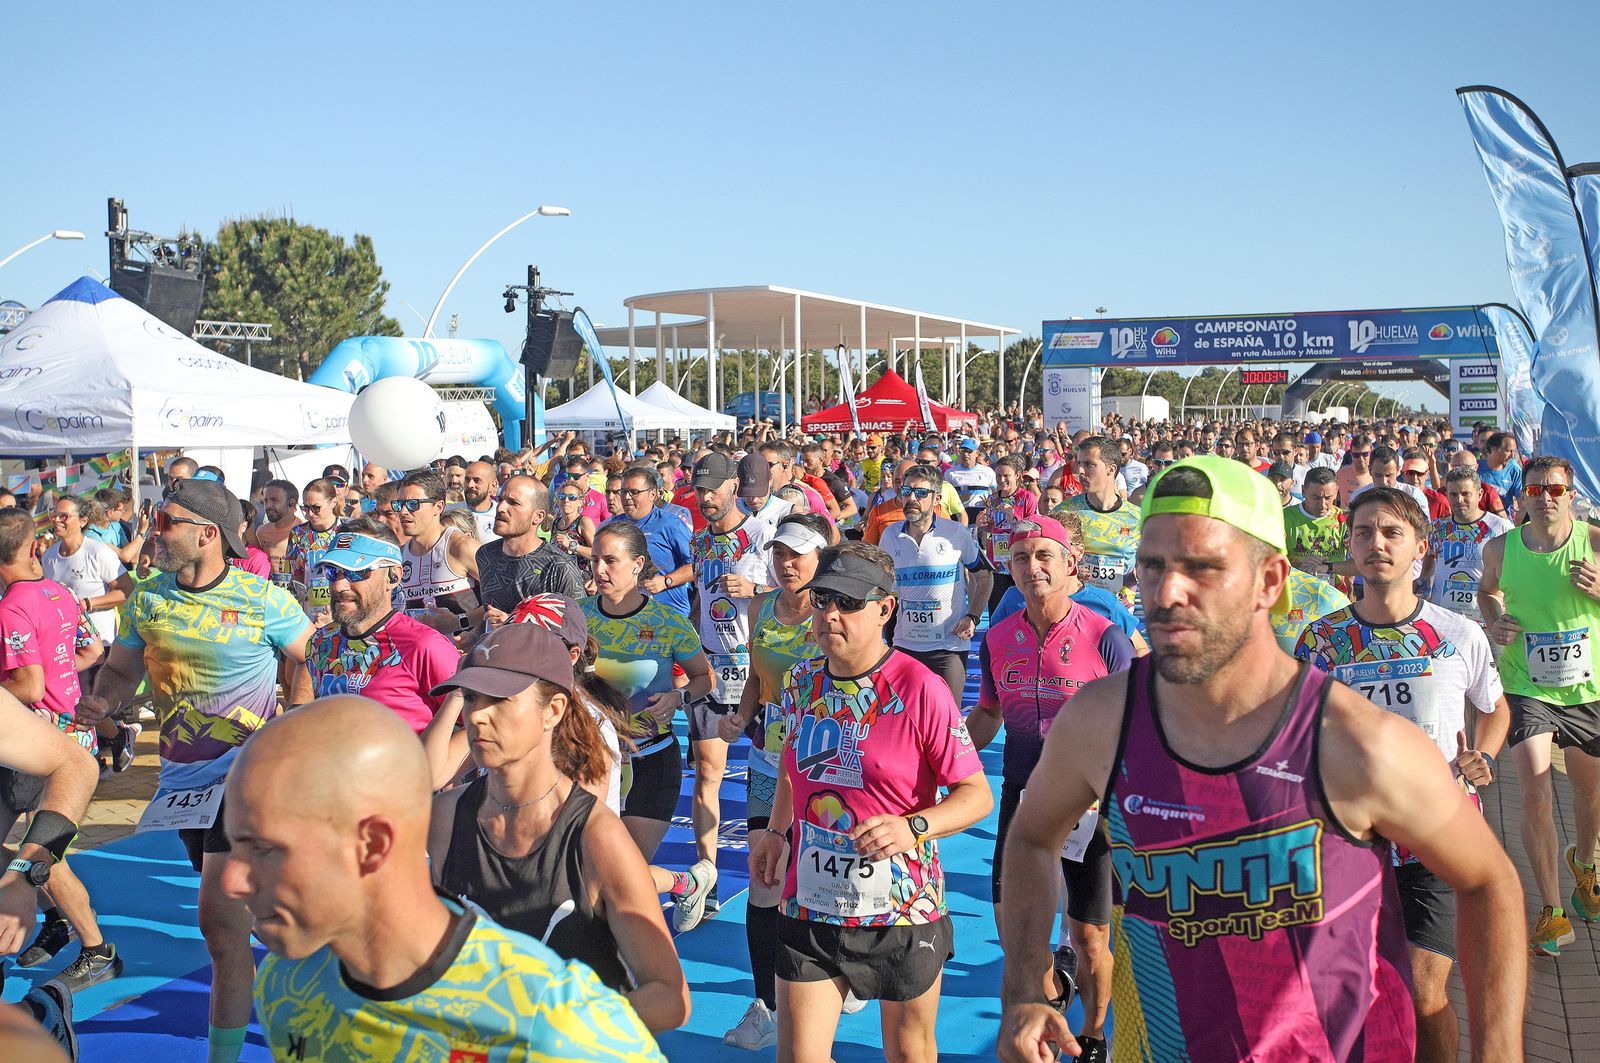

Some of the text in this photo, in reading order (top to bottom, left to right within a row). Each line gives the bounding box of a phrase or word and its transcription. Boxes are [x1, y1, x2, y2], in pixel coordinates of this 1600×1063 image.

[1195, 319, 1297, 334] CAMPEONATO
[1348, 320, 1419, 353] 10 HUELVA
[1456, 324, 1497, 337] WiHu
[1110, 327, 1133, 358] 10
[1194, 331, 1334, 349] de ESPAÑA 10 km
[1262, 349, 1296, 357] Absoluto
[26, 408, 103, 433] Cepaim
[807, 423, 841, 432] SPORT
[1442, 540, 1465, 568] 10
[1449, 590, 1477, 603] 129
[713, 623, 735, 632] WiHu
[906, 611, 934, 624] 1361
[1537, 643, 1582, 663] 1573
[722, 667, 746, 681] 851
[1397, 662, 1424, 675] 2023
[1360, 682, 1412, 706] 718
[841, 720, 869, 740] HU
[796, 714, 841, 774] 10
[841, 736, 864, 756] EL
[840, 750, 862, 770] VA
[167, 788, 214, 808] 1431
[811, 850, 874, 879] 1475
[834, 900, 859, 909] Syrluz
